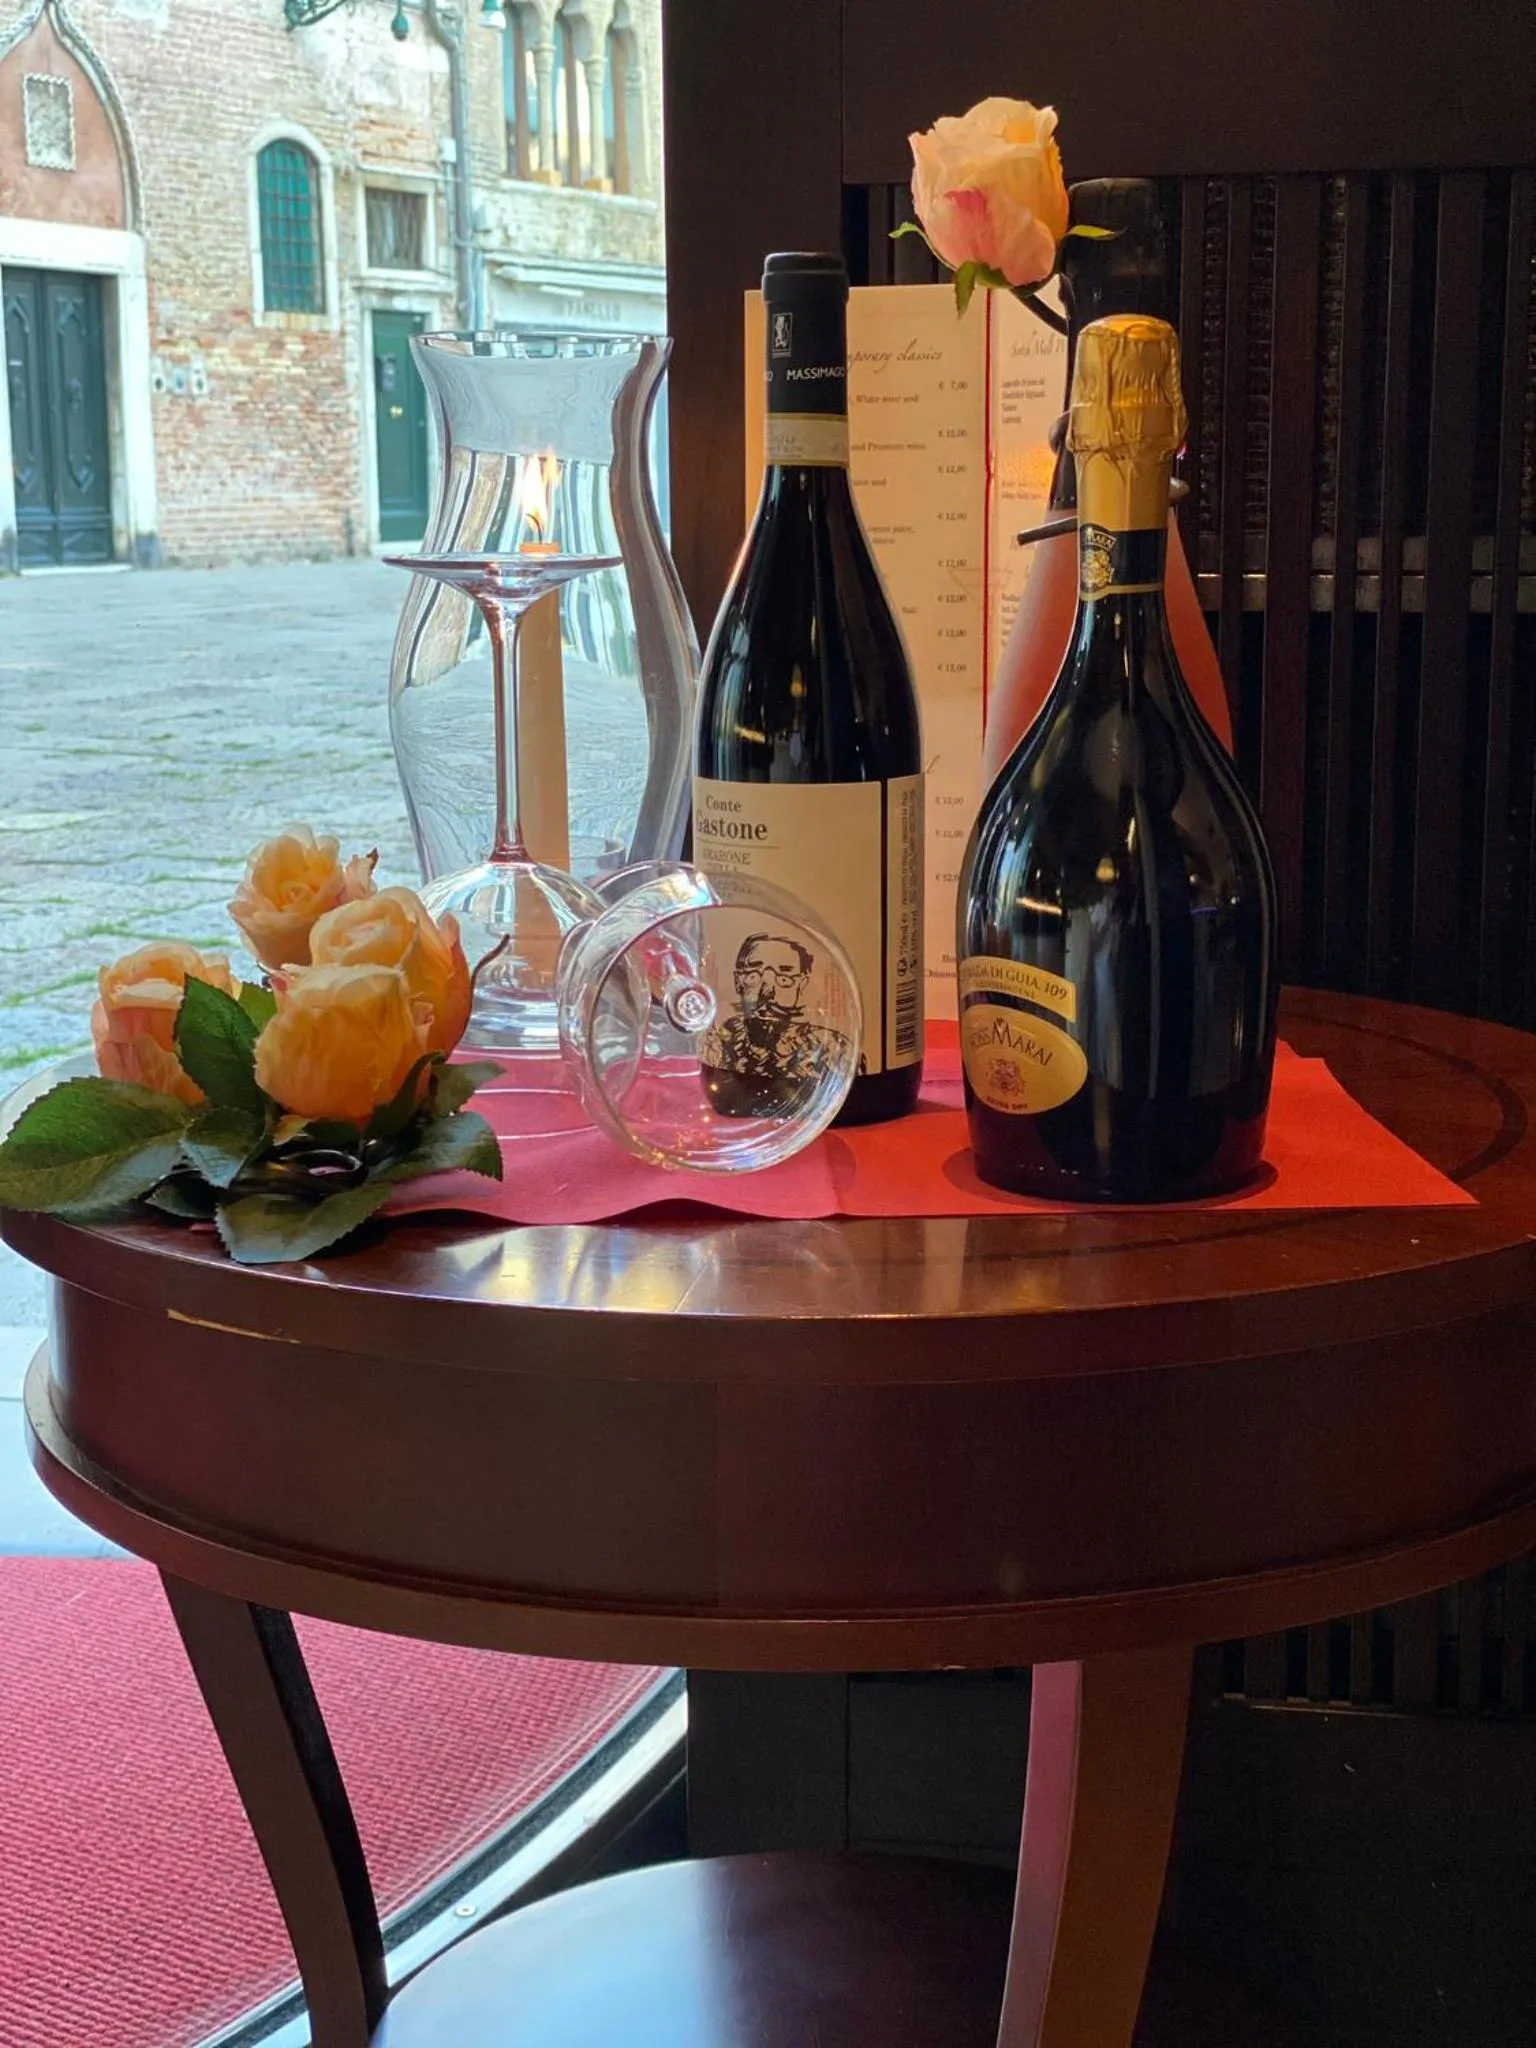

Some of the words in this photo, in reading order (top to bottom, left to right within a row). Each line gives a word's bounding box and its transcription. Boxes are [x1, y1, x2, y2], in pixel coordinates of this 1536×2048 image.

[896, 337, 943, 361] classics
[706, 794, 742, 812] Conte
[696, 808, 769, 841] Gastone
[1044, 983, 1068, 1000] 109
[992, 1019, 1053, 1067] MARAI
